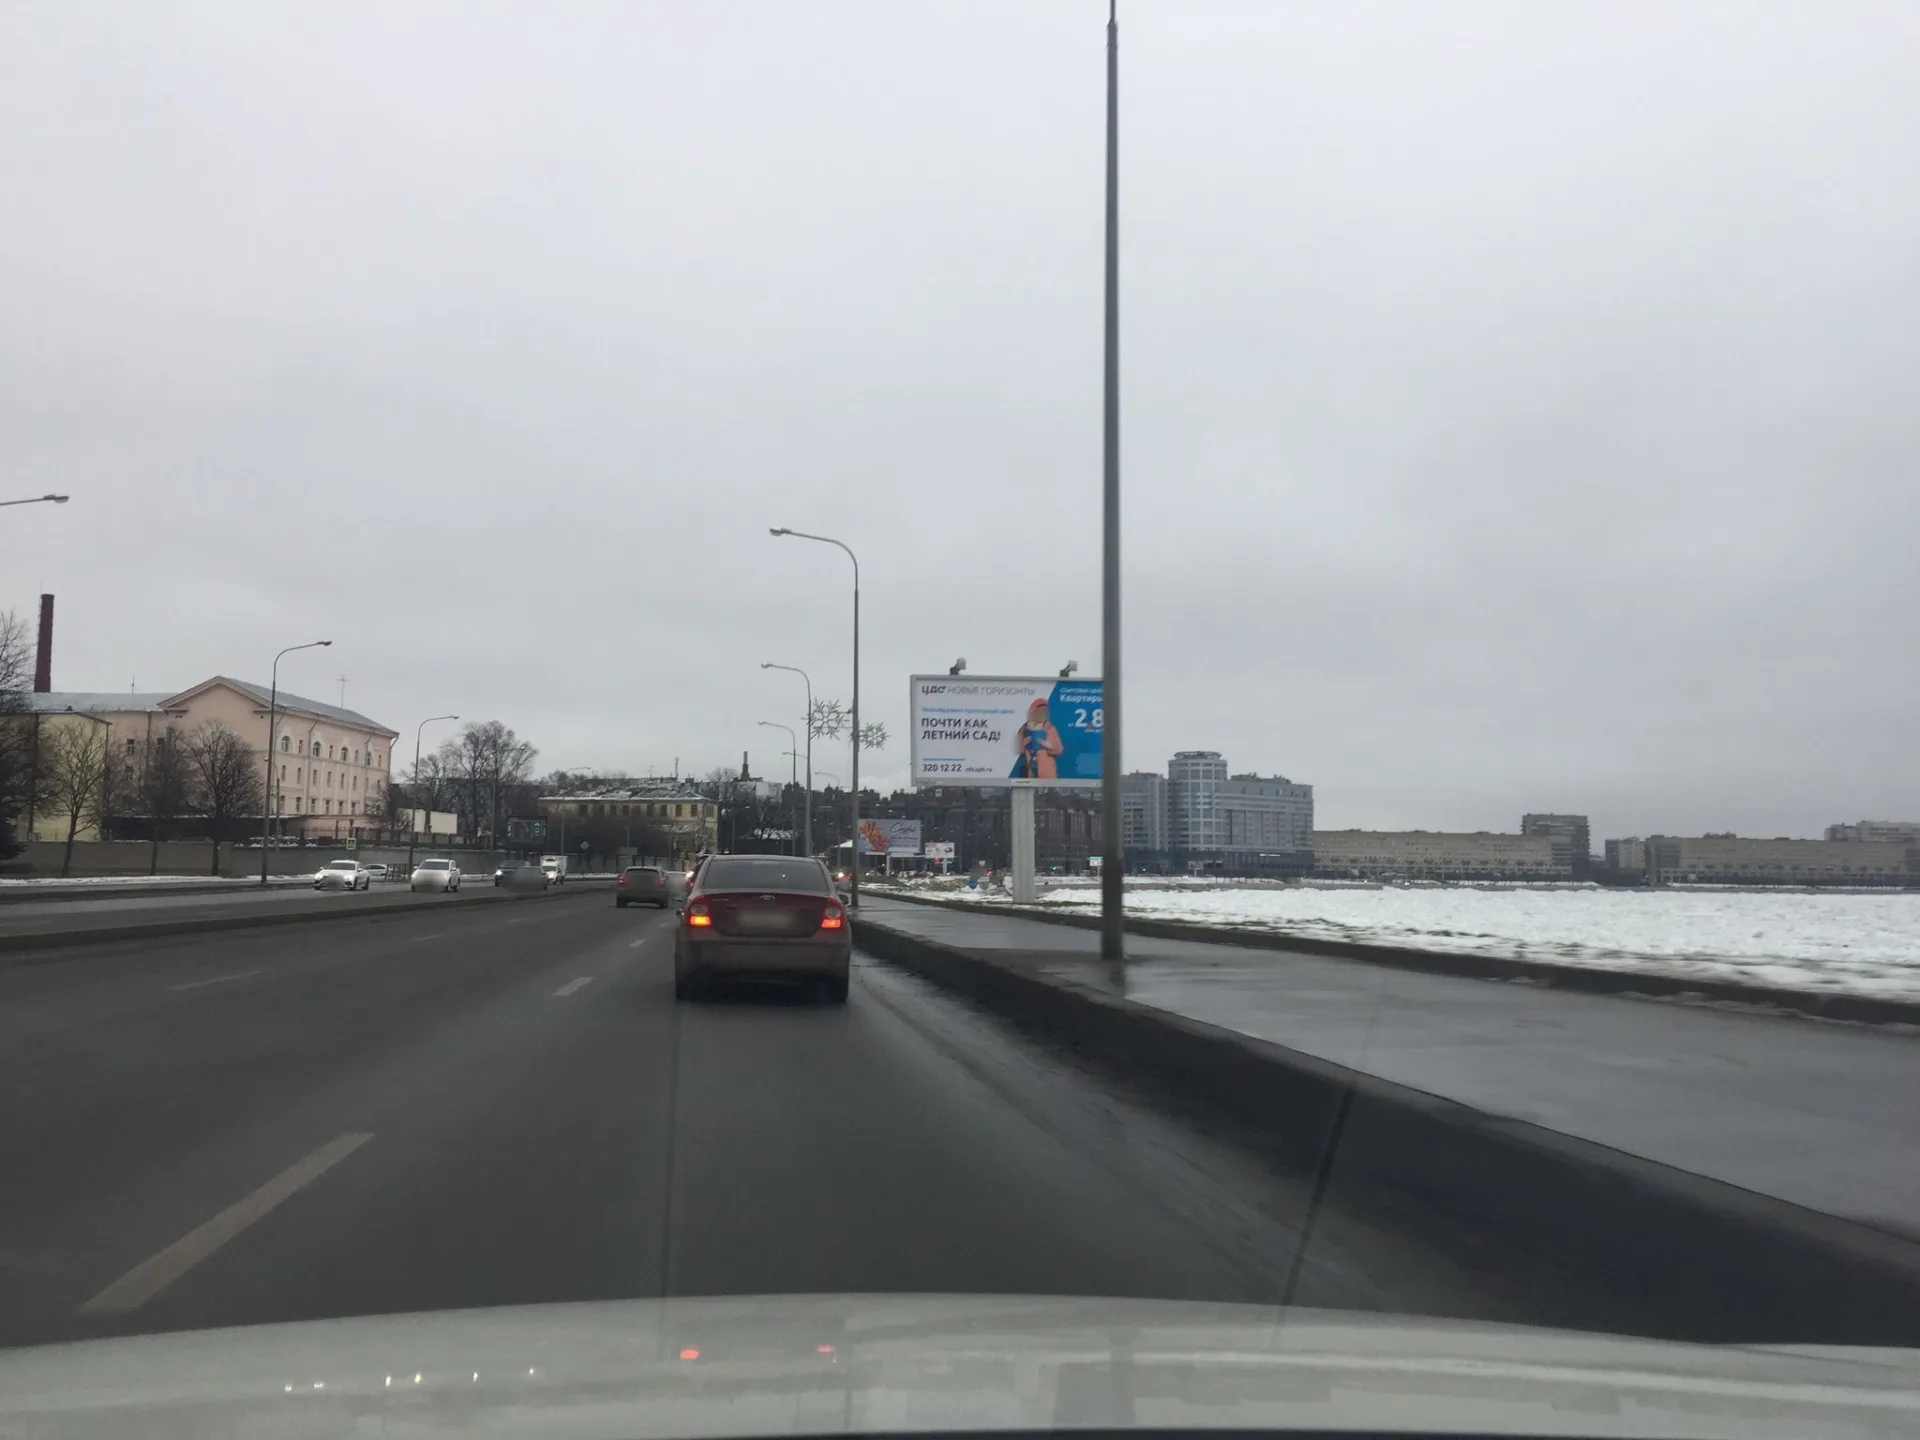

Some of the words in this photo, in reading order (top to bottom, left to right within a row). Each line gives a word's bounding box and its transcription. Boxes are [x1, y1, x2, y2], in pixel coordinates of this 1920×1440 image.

[947, 685, 979, 695] НОВЫЕ
[981, 686, 1035, 696] ГОРИЗОНТЫ
[921, 718, 961, 728] ПОЧТИ
[964, 719, 989, 729] КАК
[921, 729, 970, 740] ЛЕТНИЙ
[973, 731, 1001, 743] САД!
[922, 764, 938, 772] 320
[940, 764, 949, 772] 12
[951, 764, 962, 772] 22
